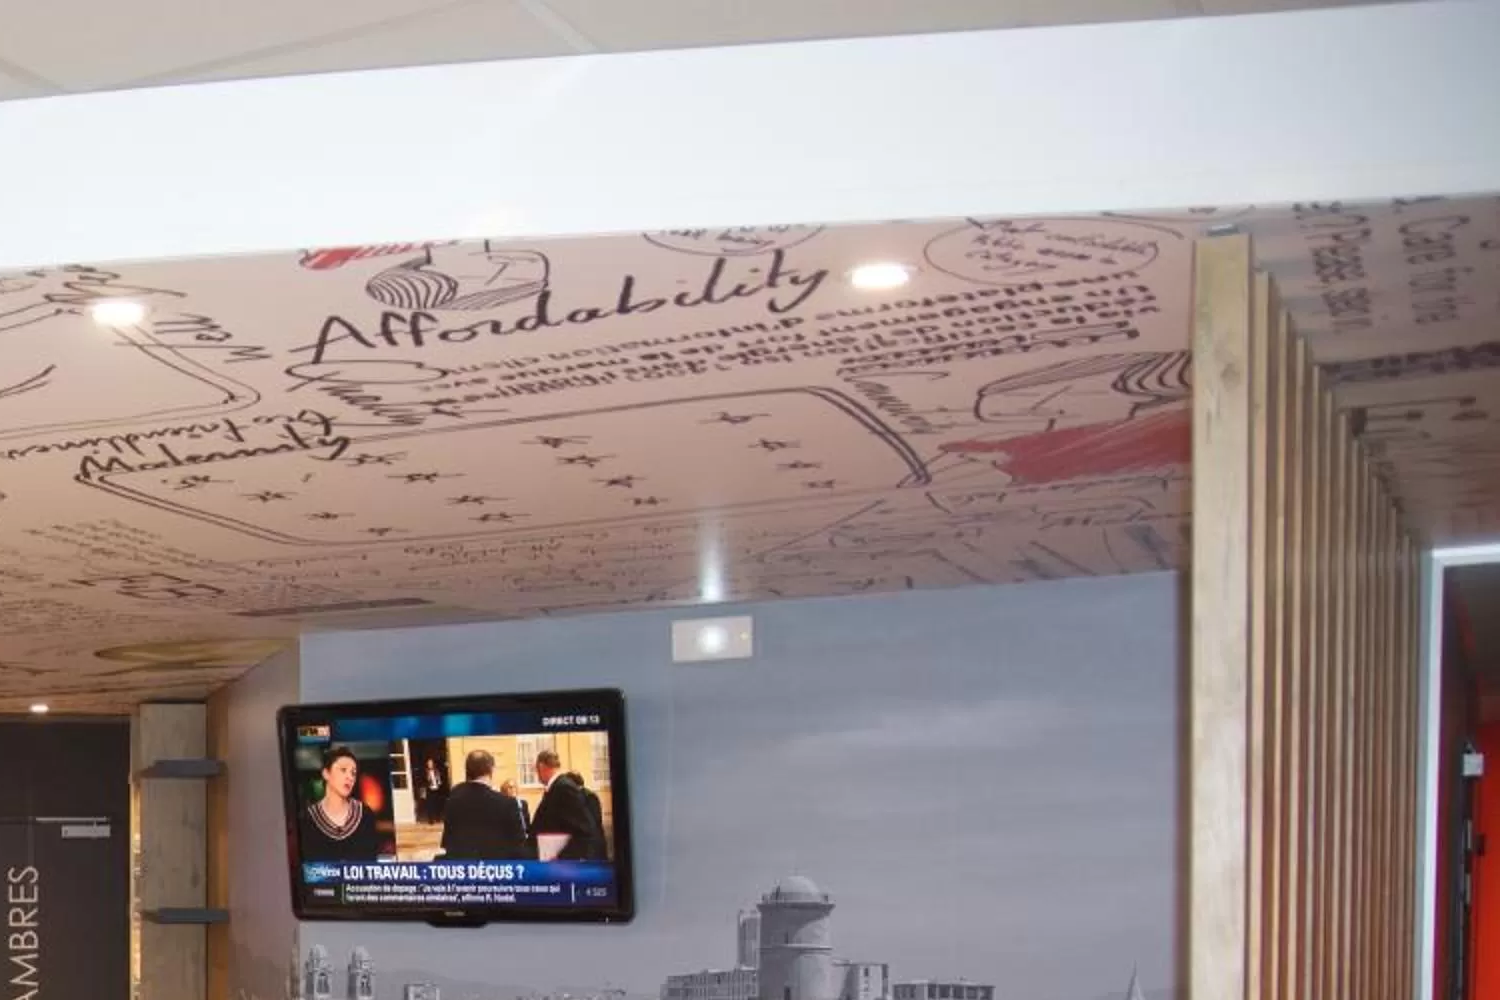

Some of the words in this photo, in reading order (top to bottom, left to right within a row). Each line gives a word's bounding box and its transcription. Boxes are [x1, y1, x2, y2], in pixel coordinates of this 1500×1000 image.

[288, 248, 829, 364] Affordability
[815, 281, 1043, 323] plateforme
[819, 291, 1073, 337] engagement
[79, 424, 351, 479] Modernity
[343, 865, 363, 880] LOI
[366, 865, 421, 880] TRAVAIL
[430, 864, 466, 880] TOUS
[468, 861, 515, 882] DÉÇUS
[516, 865, 525, 880] ?
